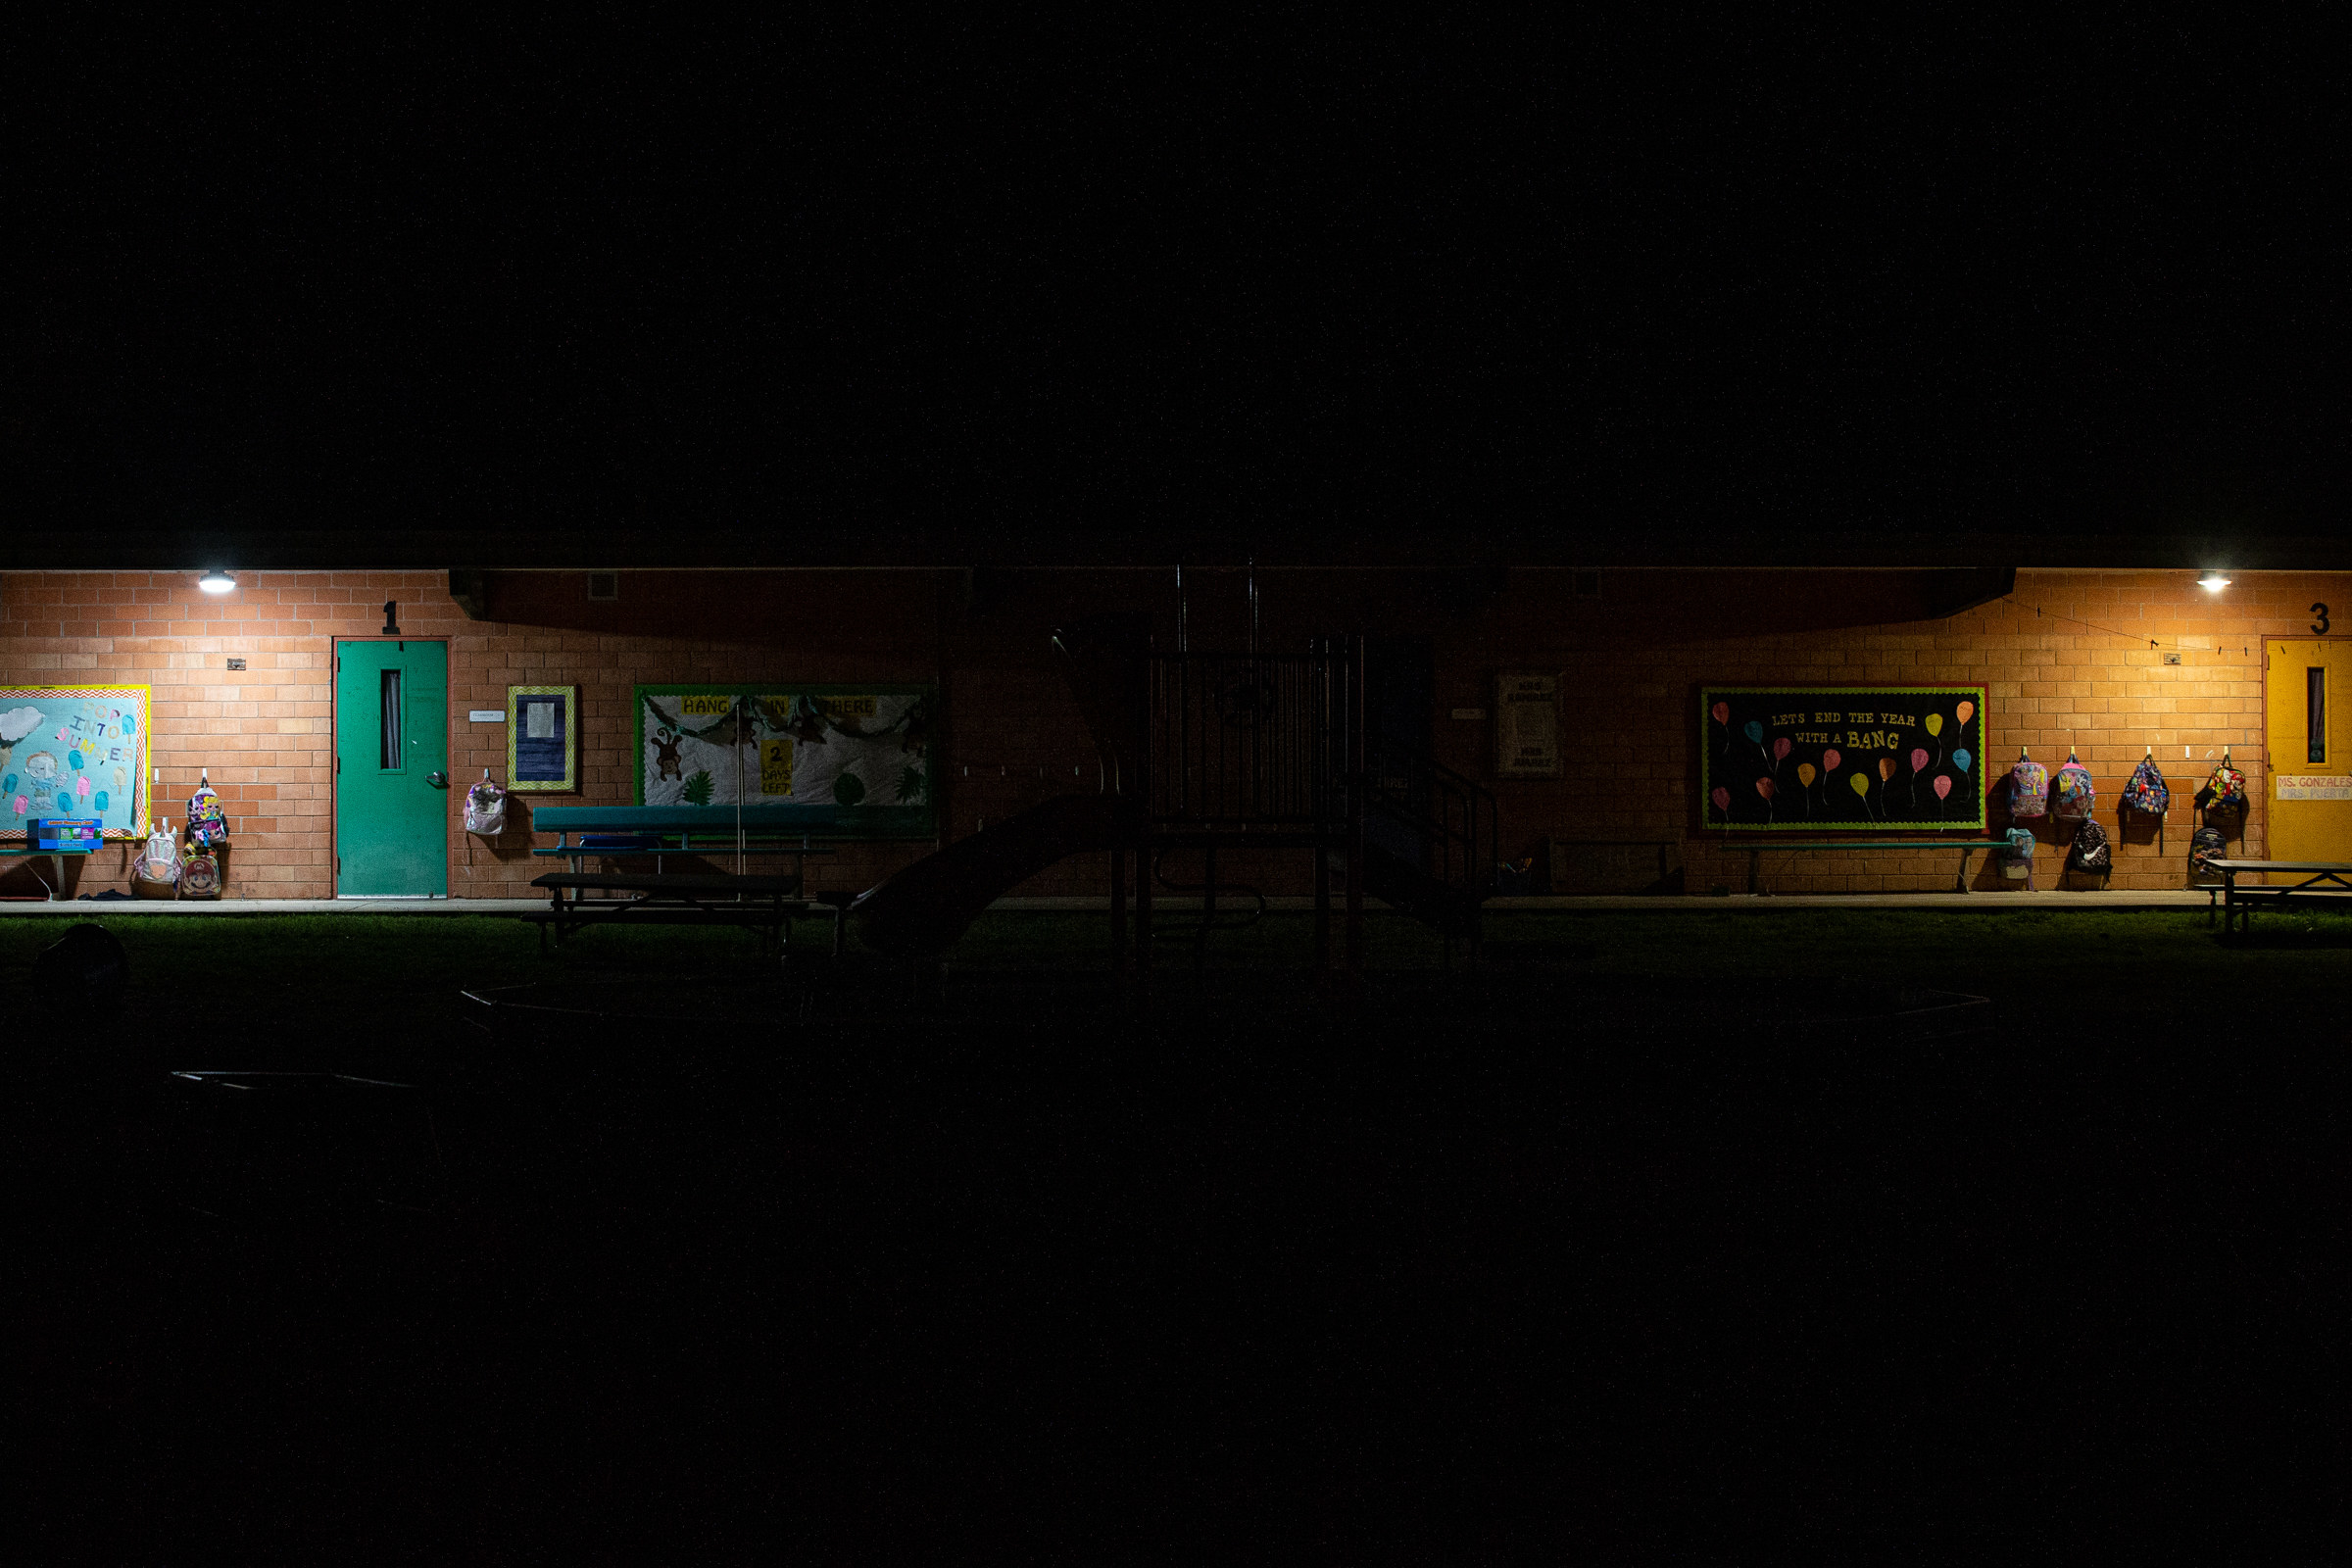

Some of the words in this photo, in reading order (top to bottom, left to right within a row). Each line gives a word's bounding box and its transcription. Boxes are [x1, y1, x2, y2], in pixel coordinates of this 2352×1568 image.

[382, 600, 401, 634] 1
[2309, 602, 2330, 635] 3
[83, 701, 121, 721] POP
[683, 700, 727, 713] HANG
[770, 700, 785, 713] IN
[821, 700, 873, 713] THERE
[70, 715, 120, 740] INTO
[1772, 713, 1805, 726] LETS
[1814, 712, 1840, 723] END
[1848, 712, 1874, 723] THE
[1880, 712, 1916, 727] YEAR
[55, 727, 134, 763] SUMMER
[1794, 732, 1828, 743] WITH
[1833, 733, 1841, 744] A
[1846, 729, 1899, 750] BANG
[770, 747, 782, 761] 2
[762, 768, 791, 780] DAYS
[2278, 777, 2296, 787] MS.
[2299, 777, 2352, 787] GONZALES
[762, 782, 791, 794] LEFT
